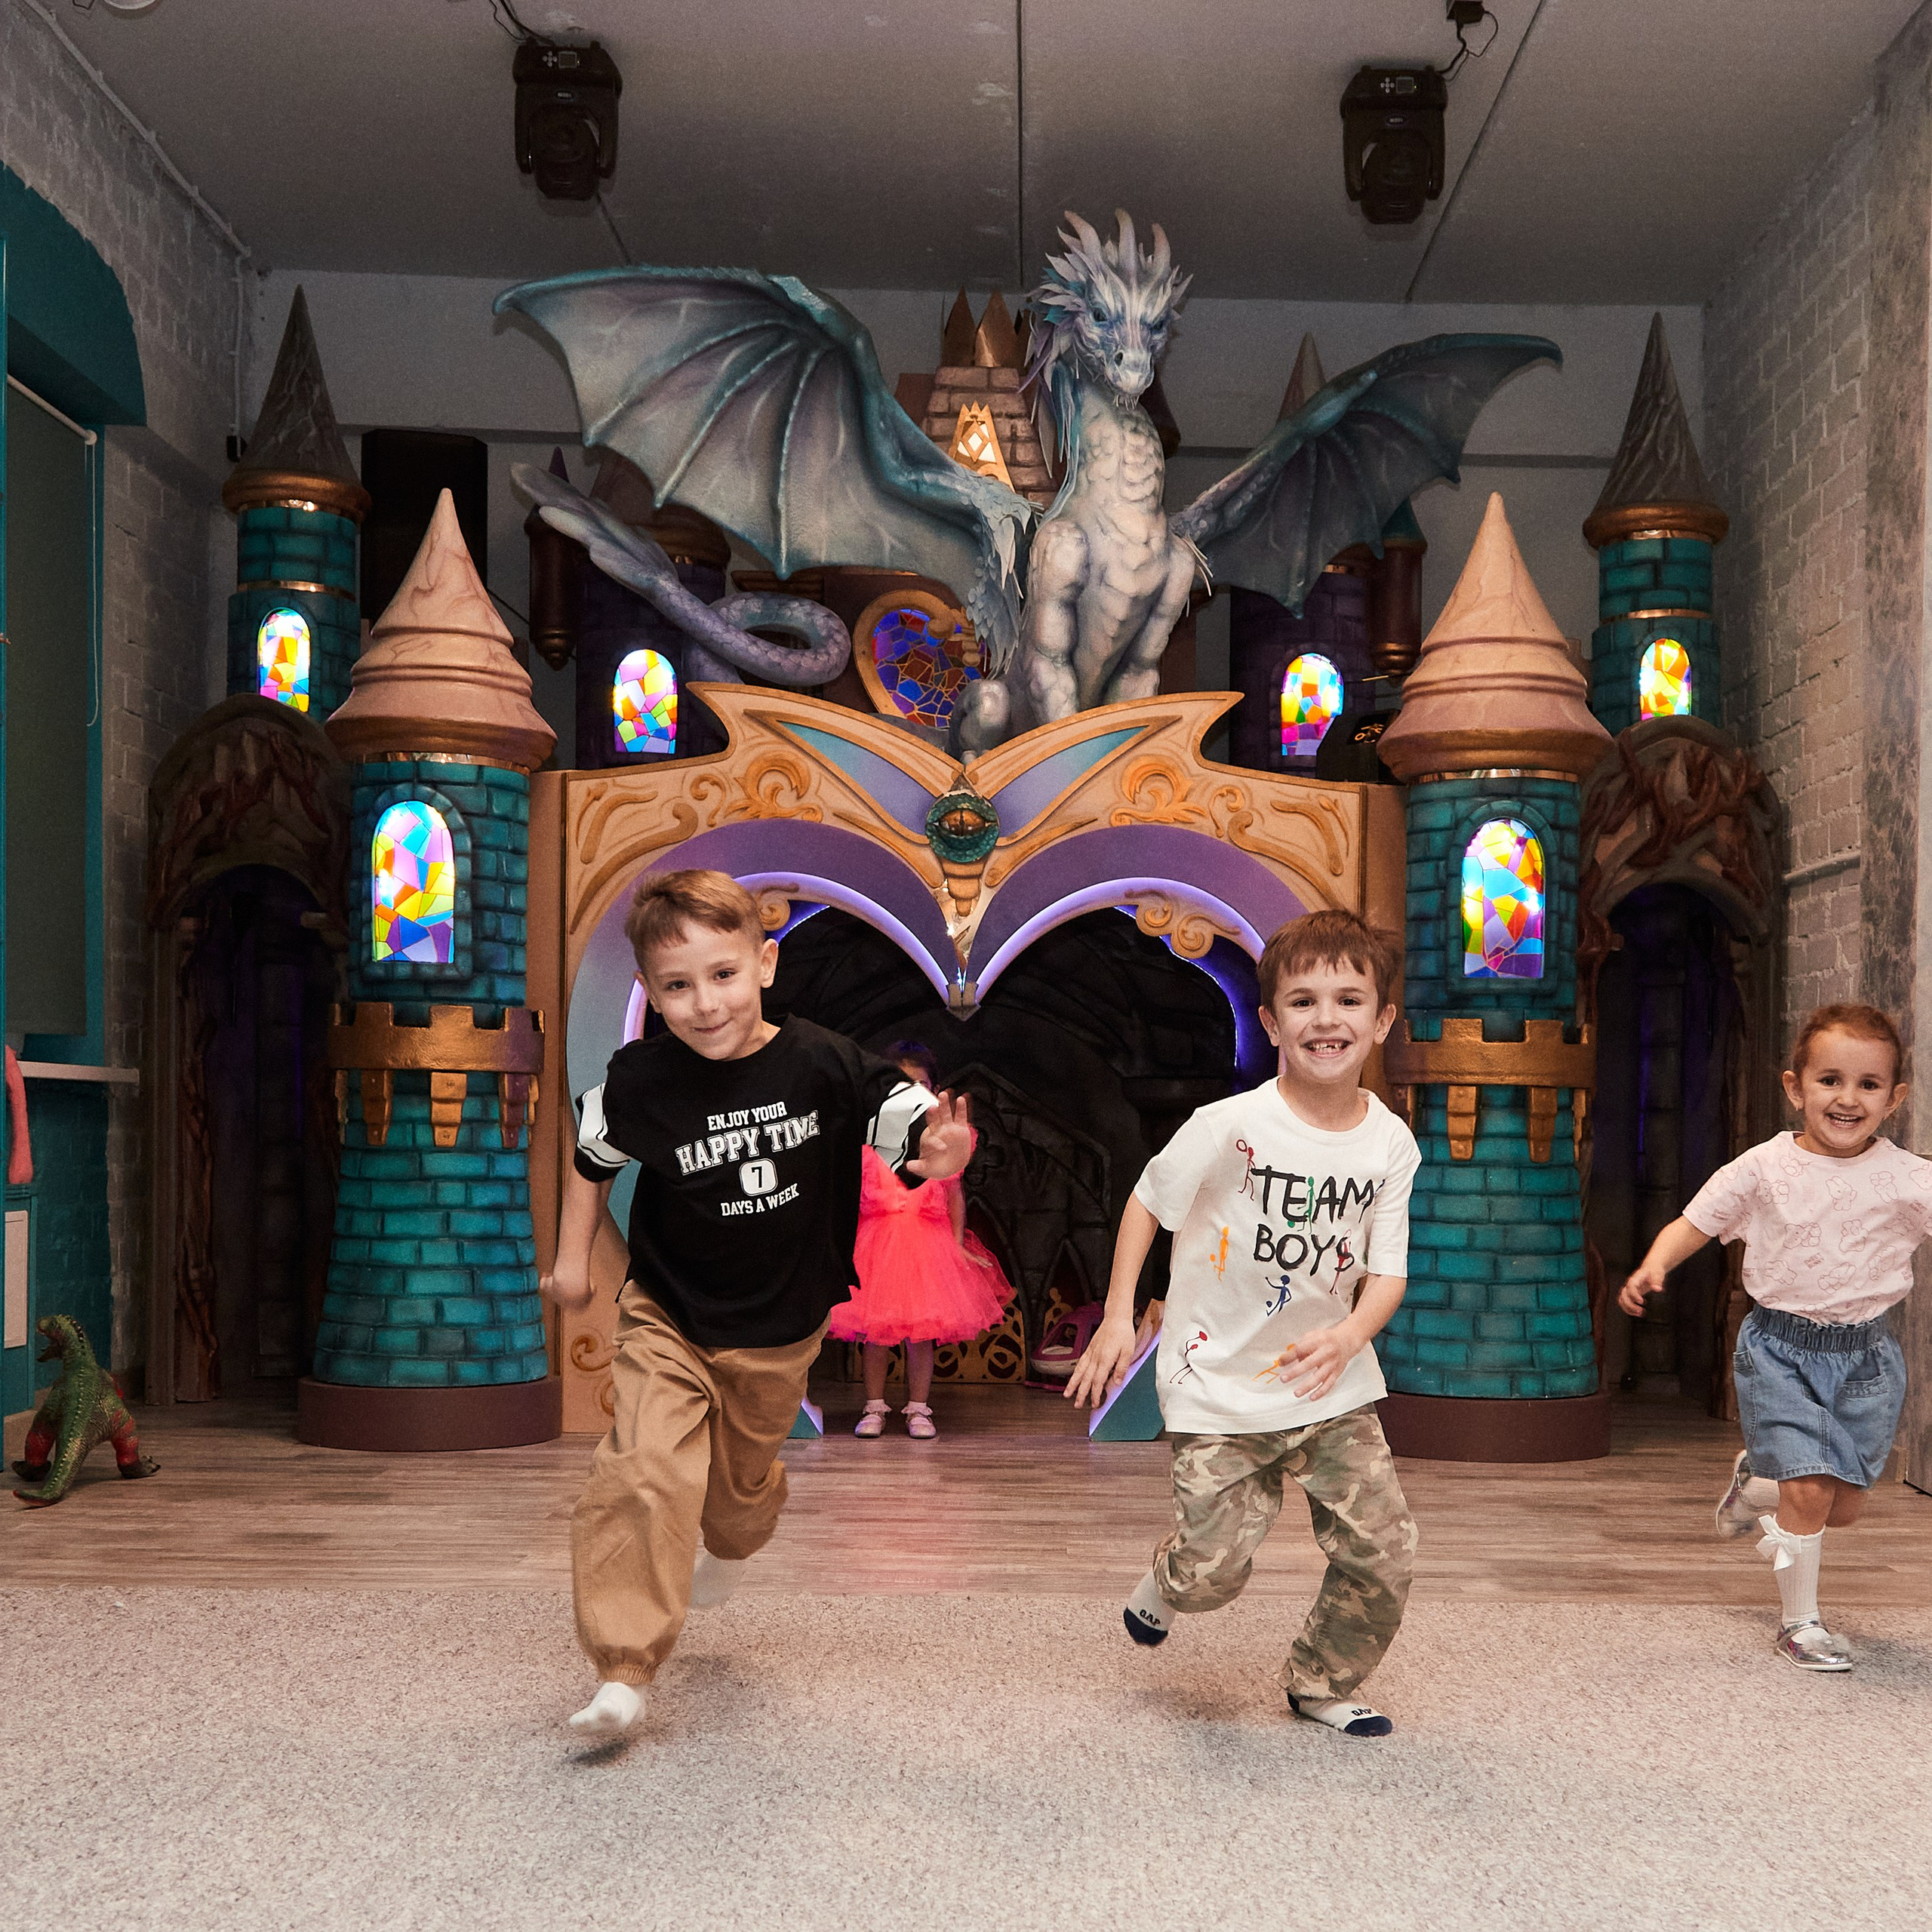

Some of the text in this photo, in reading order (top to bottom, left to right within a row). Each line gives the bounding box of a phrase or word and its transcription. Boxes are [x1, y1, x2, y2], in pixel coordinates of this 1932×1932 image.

[707, 1101, 787, 1131] ENJOY YOUR
[675, 1110, 820, 1176] HAPPY TIME
[751, 1166, 763, 1189] 7
[721, 1183, 799, 1217] DAYS A WEEK
[1250, 1165, 1375, 1224] TEAM
[1254, 1223, 1355, 1277] BOYS
[1140, 1609, 1161, 1626] GAP
[1351, 1708, 1372, 1716] GAP
